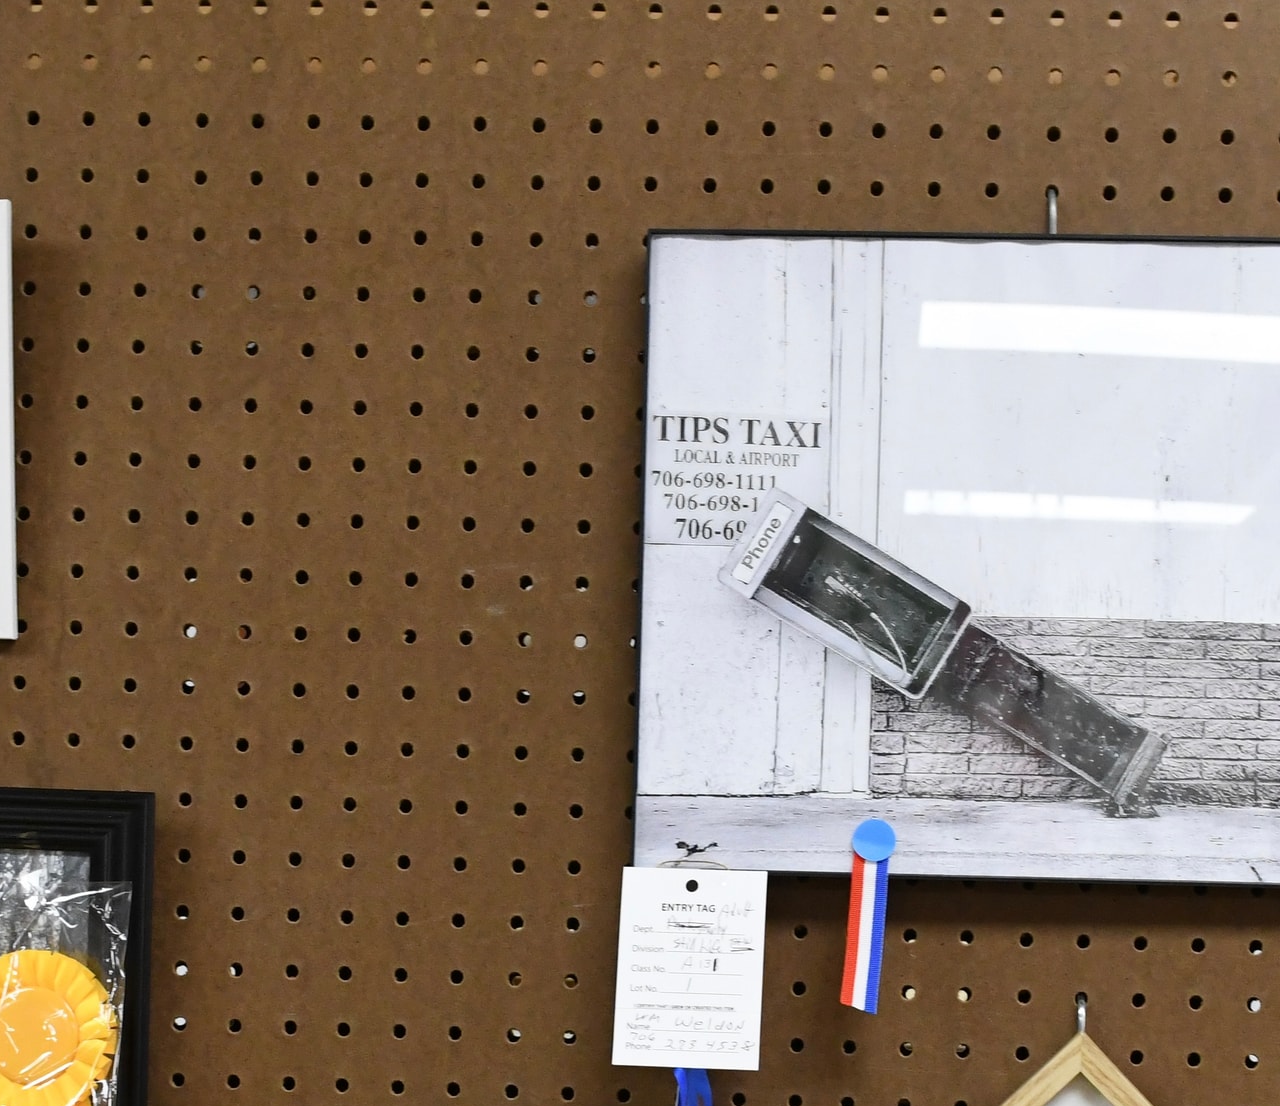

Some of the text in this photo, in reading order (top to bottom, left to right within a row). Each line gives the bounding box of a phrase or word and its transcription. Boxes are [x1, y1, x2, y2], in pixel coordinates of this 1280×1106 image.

[653, 415, 822, 449] TIPS TAXI
[674, 448, 800, 468] LOCAL & AIRPORT
[651, 470, 777, 491] 706-698-1111
[741, 517, 782, 571] Phone
[661, 903, 716, 913] ENTRY TAG
